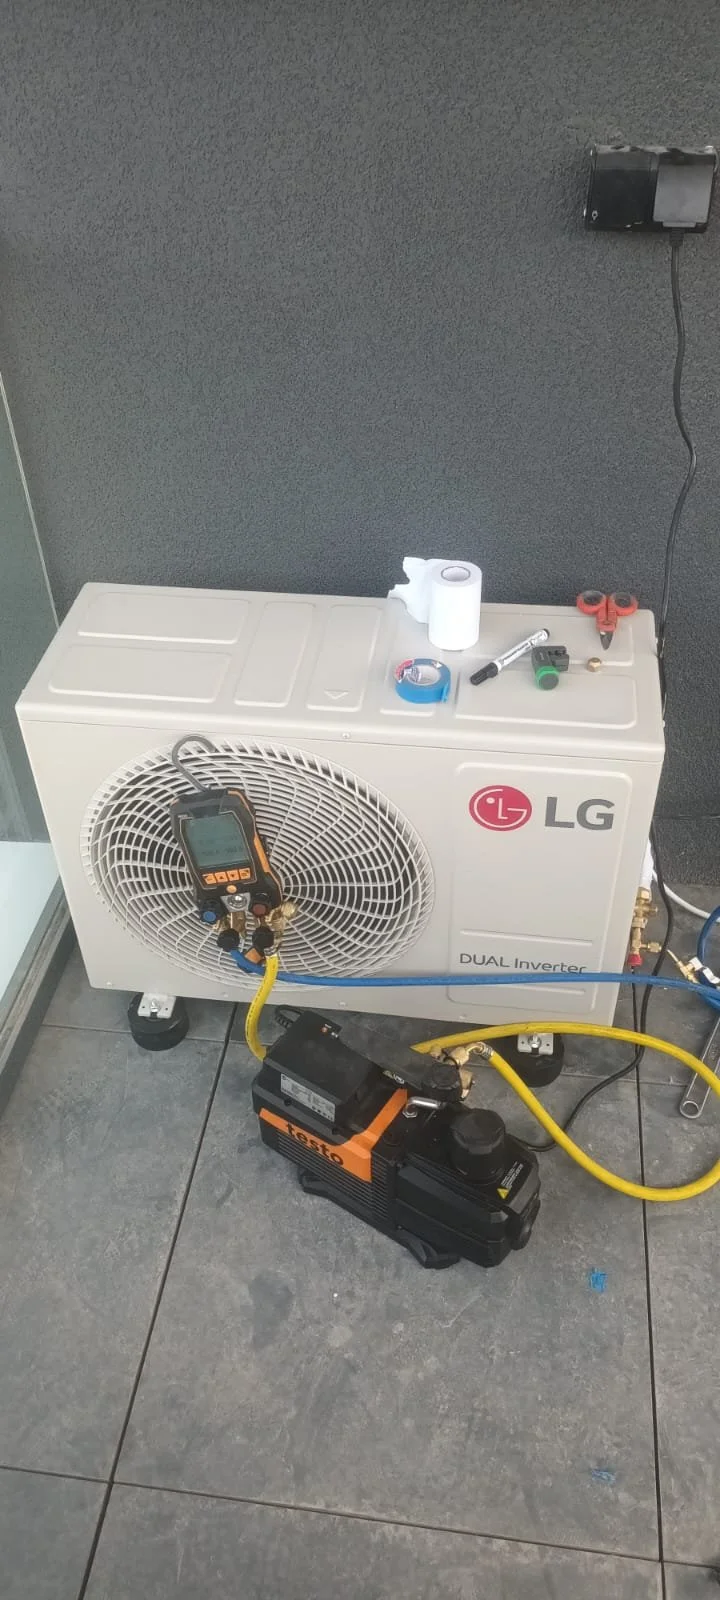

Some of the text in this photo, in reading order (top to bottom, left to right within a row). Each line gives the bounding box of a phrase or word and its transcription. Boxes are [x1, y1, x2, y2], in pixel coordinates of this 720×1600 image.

[544, 796, 615, 831] LG
[460, 953, 587, 975] DUAL Inverter
[286, 1123, 344, 1165] testo
